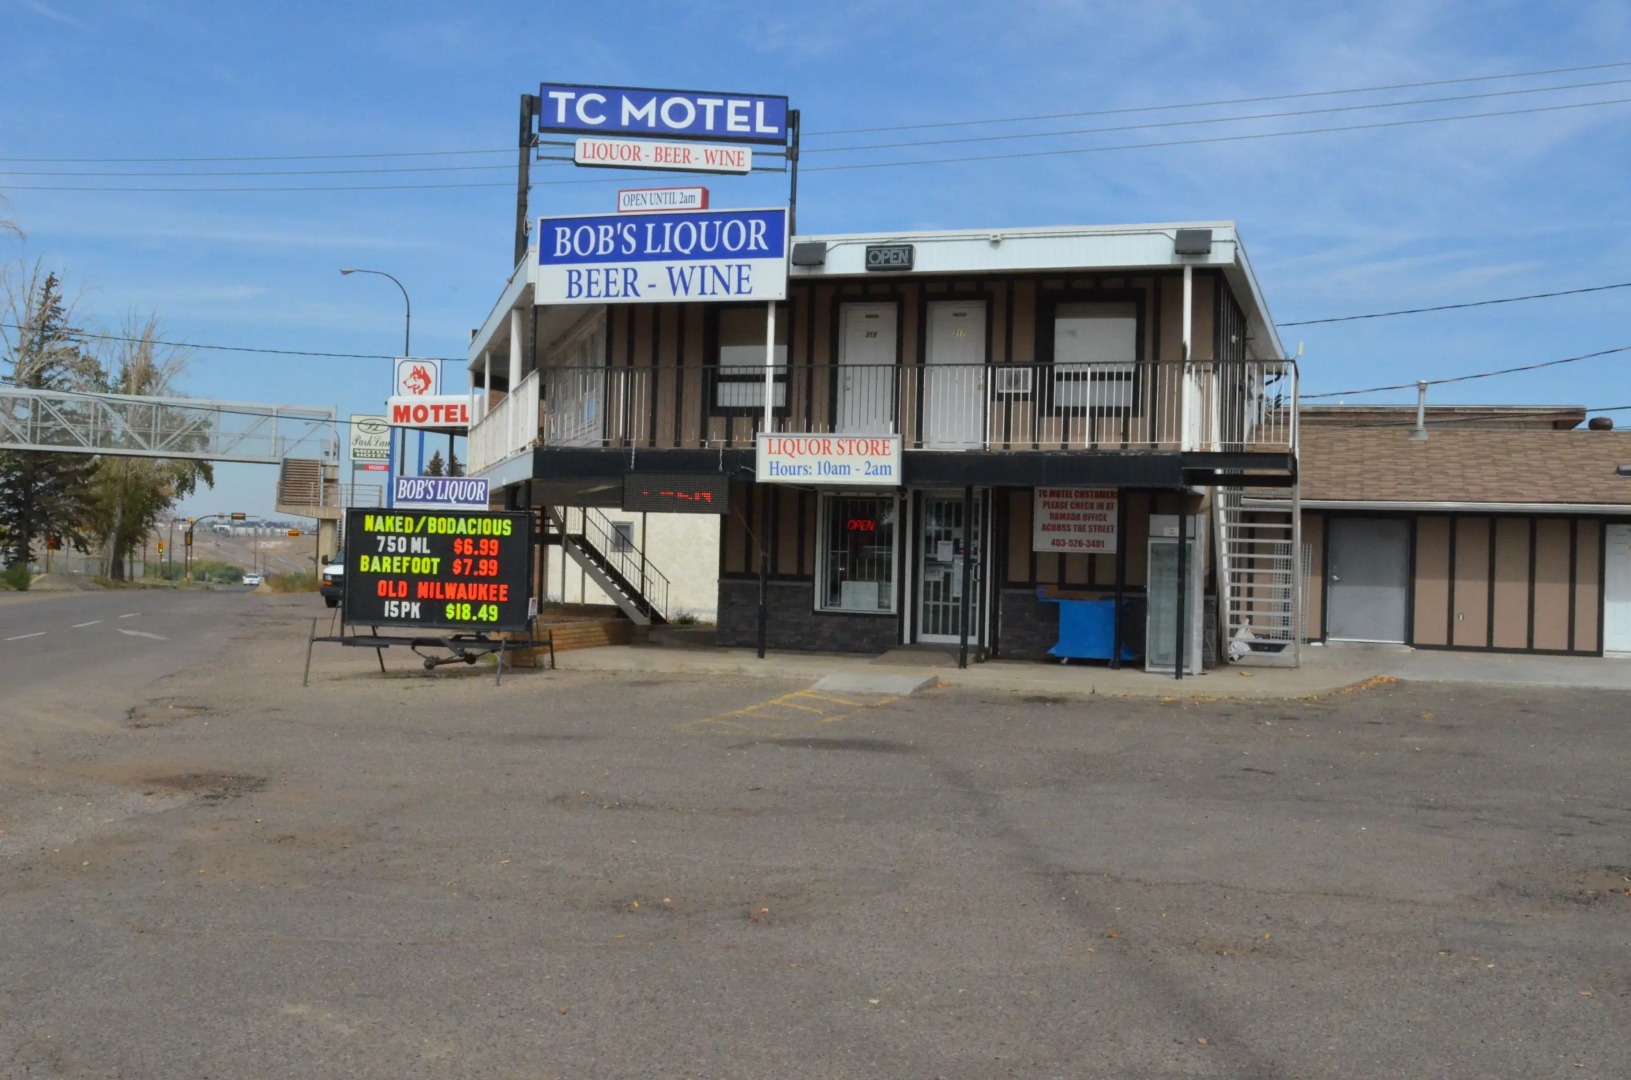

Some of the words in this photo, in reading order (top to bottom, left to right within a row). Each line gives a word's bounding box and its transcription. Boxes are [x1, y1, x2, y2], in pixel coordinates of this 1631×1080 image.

[548, 91, 607, 125] TC
[621, 95, 778, 134] MOTEL
[582, 142, 642, 162] LIQUOR
[653, 147, 692, 164] BEER
[704, 149, 745, 167] WINE
[622, 193, 647, 207] OPEN
[649, 192, 677, 206] UNTIL
[679, 192, 696, 205] 2am
[553, 222, 637, 257] BOB'S
[643, 219, 769, 255] LIQUOR
[868, 249, 908, 264] OPEN
[565, 267, 641, 299] BEER
[665, 264, 753, 297] WINE
[393, 404, 469, 423] MOTEL
[767, 438, 833, 458] LIQUOR
[836, 439, 891, 456] STORE
[769, 460, 812, 476] Hours:
[817, 460, 851, 476] 10am
[864, 460, 892, 476] 2am
[397, 479, 435, 499] BOB'S
[436, 480, 486, 504] LIQUOR
[1042, 501, 1068, 510] PLEASE
[1070, 501, 1095, 510] CHECK
[1106, 502, 1115, 511] AT
[364, 514, 512, 536] NAKED/BODACIOUS
[846, 519, 875, 532] OPEN
[1082, 513, 1107, 522] OFFICE
[1041, 523, 1071, 533] ACROSS
[1073, 524, 1086, 533] THE
[1088, 524, 1115, 534] STREET
[376, 535, 407, 553] 750
[411, 536, 431, 554] ML
[453, 538, 499, 556] $6.99
[360, 555, 441, 575] BAREFOOT
[452, 558, 499, 577] $7.99
[377, 579, 409, 597] OLD
[417, 581, 509, 602] MILWAUKEE
[445, 602, 499, 622] $18.49
